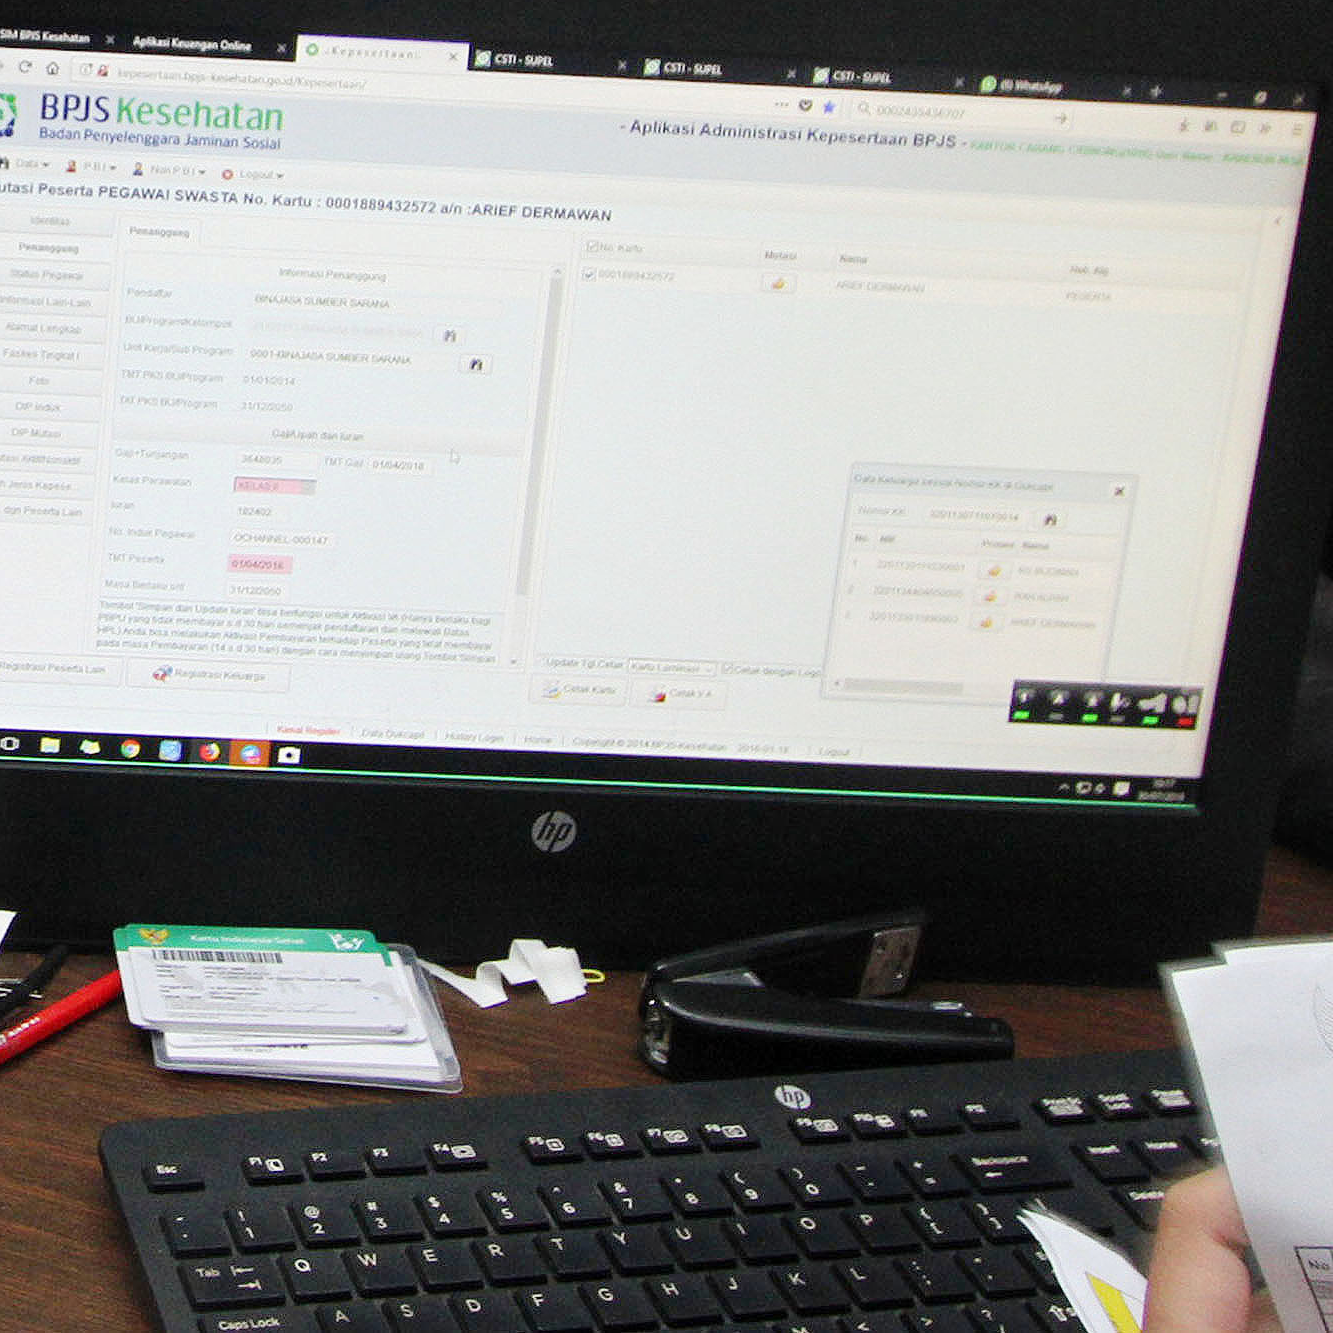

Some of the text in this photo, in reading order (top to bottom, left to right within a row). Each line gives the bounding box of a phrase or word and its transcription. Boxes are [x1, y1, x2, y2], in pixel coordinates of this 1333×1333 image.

[43, 32, 90, 44] Kesehatan
[133, 36, 170, 50] Aplikasi
[221, 39, 252, 52] Online
[40, 92, 284, 132] BPJS Kesehatan
[39, 126, 282, 151] Badan Penyelenggara Jaminan Sosial
[630, 120, 957, 148] Aplikasi Administrasi Kepesertaan BPJS
[37, 182, 94, 197] Peserta
[97, 185, 169, 200] PEGAWAI
[174, 190, 239, 204] SWASTA
[243, 193, 268, 206] No.
[271, 194, 313, 209] Kartu
[324, 197, 437, 215] 0001889432572
[439, 202, 463, 216] a/n
[521, 205, 612, 222] DERMAWAN
[536, 811, 574, 850] hp
[779, 1087, 807, 1107] hp
[157, 1165, 180, 1175] Esc
[312, 1222, 325, 1235] 2
[375, 1217, 387, 1229] 3
[439, 1213, 450, 1224] 4
[501, 1208, 513, 1219] 5
[563, 1202, 576, 1215] 6
[623, 1197, 633, 1209] 7
[685, 1192, 699, 1204] 8
[745, 1189, 759, 1200] 9
[195, 1214, 873, 1278] Tab Q W E R T Y U O P
[218, 1319, 250, 1333] Caps
[252, 1317, 280, 1328] Lock
[335, 1309, 351, 1323] A
[401, 1304, 414, 1318] S
[465, 1299, 481, 1313] D
[532, 1294, 545, 1307] F
[598, 1288, 614, 1302] G
[662, 1283, 679, 1297] H
[789, 1273, 805, 1287] K
[850, 1267, 866, 1280] L
